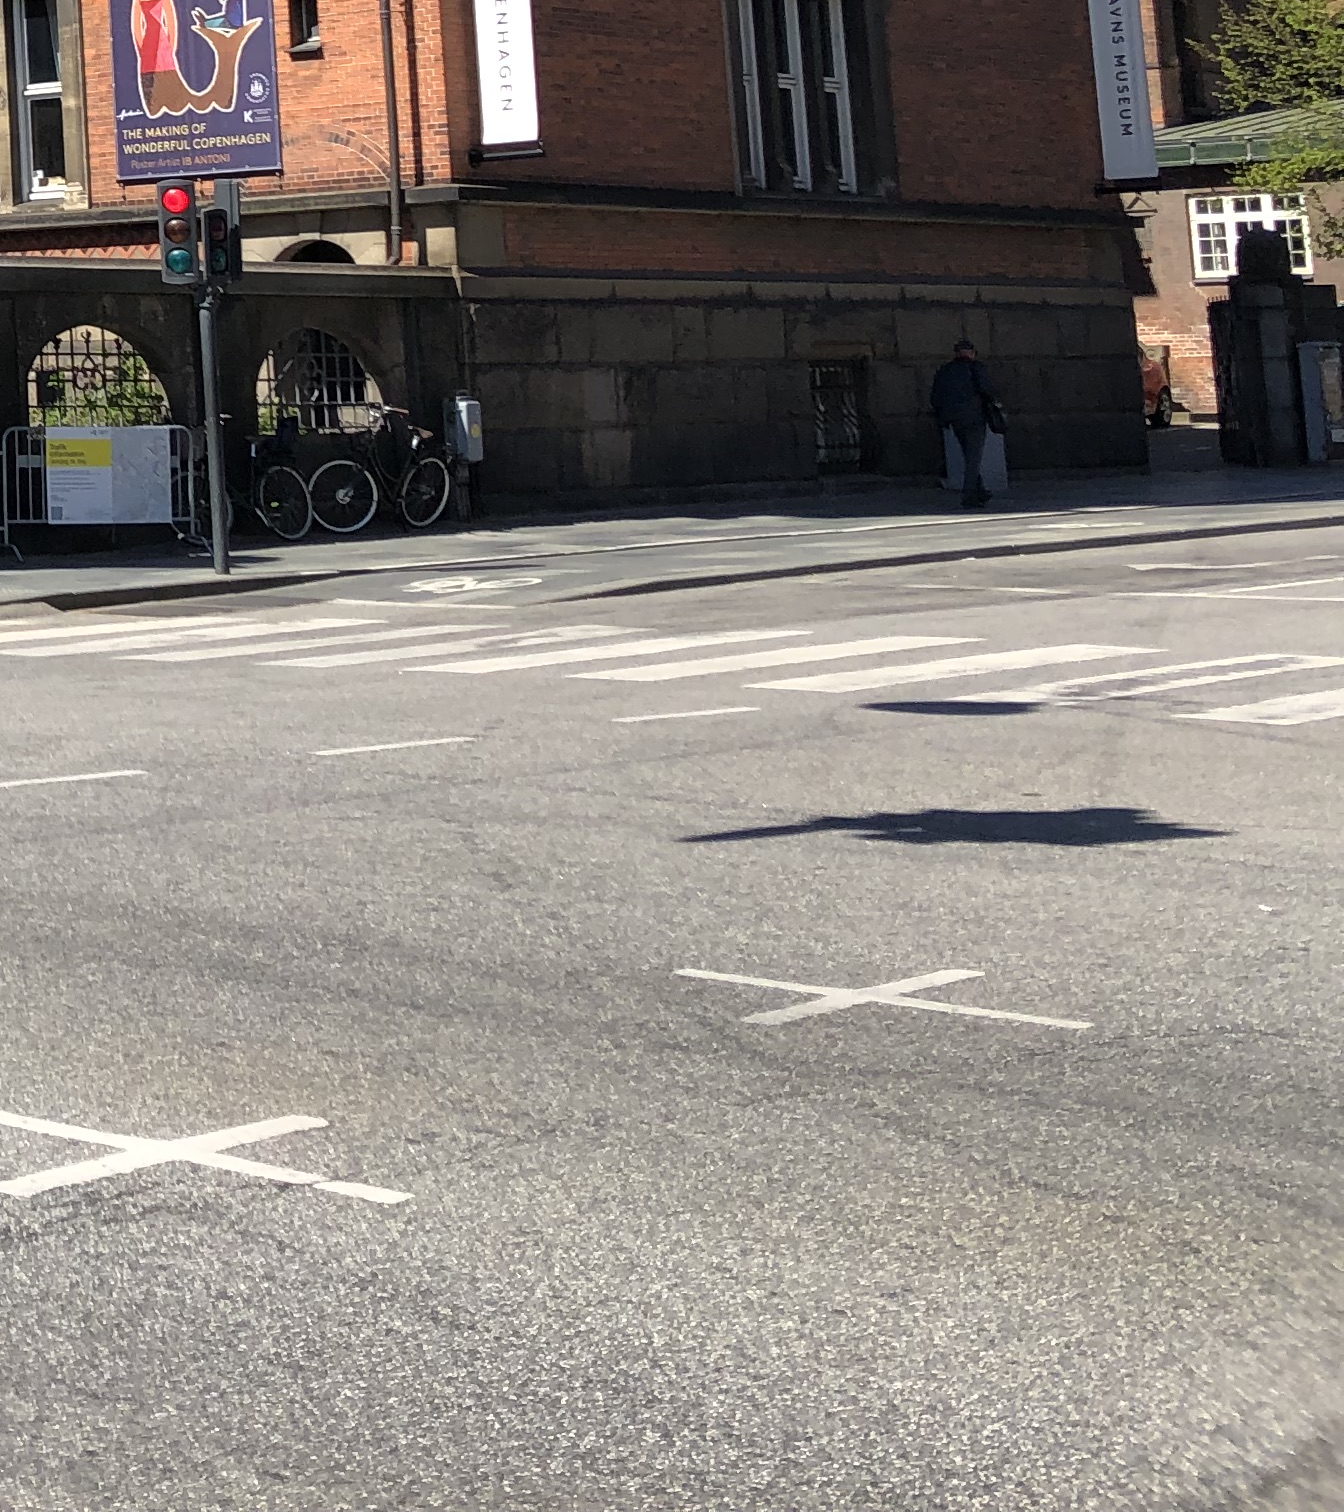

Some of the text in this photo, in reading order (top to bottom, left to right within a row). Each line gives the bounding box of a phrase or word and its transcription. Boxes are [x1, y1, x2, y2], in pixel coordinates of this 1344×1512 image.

[1113, 54, 1134, 138] MUSEUM
[122, 123, 207, 140] THE MAKING OF
[122, 133, 272, 155] WONDERFUL COPENHAGEN
[182, 156, 193, 166] IB
[194, 153, 231, 165] ANTONI
